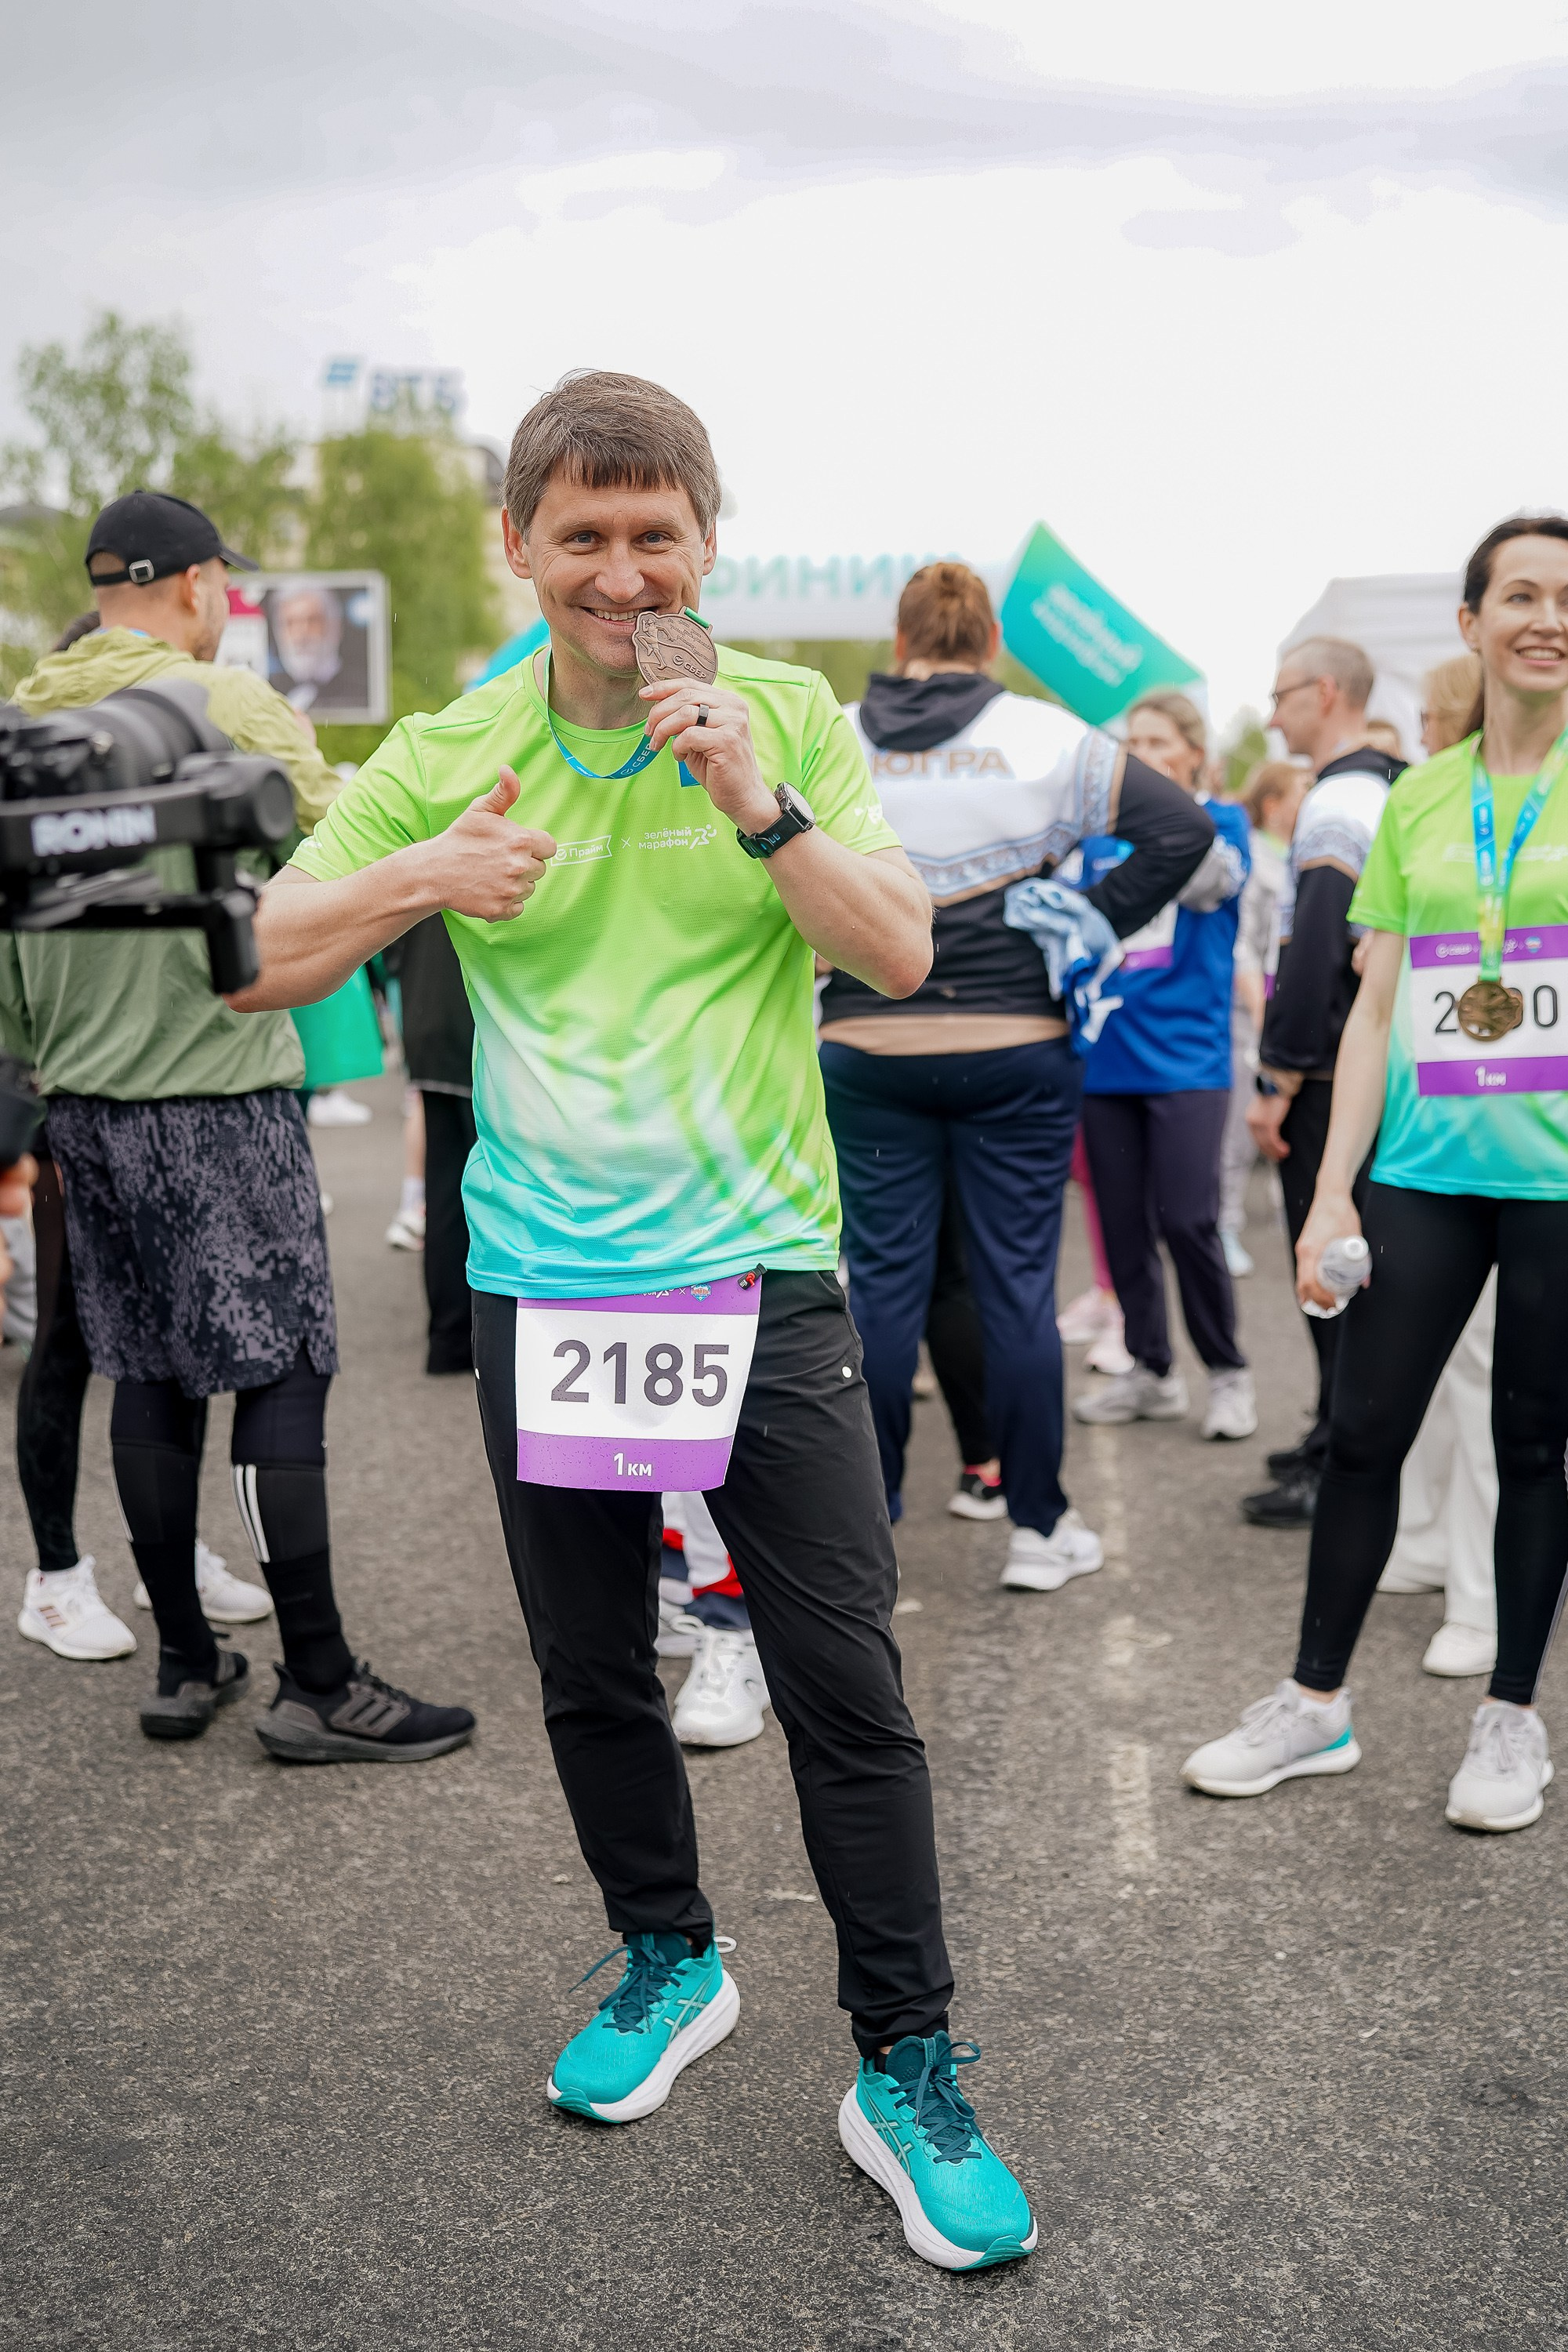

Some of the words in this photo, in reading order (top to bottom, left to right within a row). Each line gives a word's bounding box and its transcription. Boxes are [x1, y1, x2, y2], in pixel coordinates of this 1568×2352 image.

[684, 662, 706, 679] СБЕР
[872, 750, 1011, 777] ЮГРА
[644, 826, 692, 840] зелёный
[568, 844, 604, 858] Прайм
[638, 837, 688, 851] марафон
[1434, 985, 1559, 1034] 20
[550, 1339, 730, 1407] 2185
